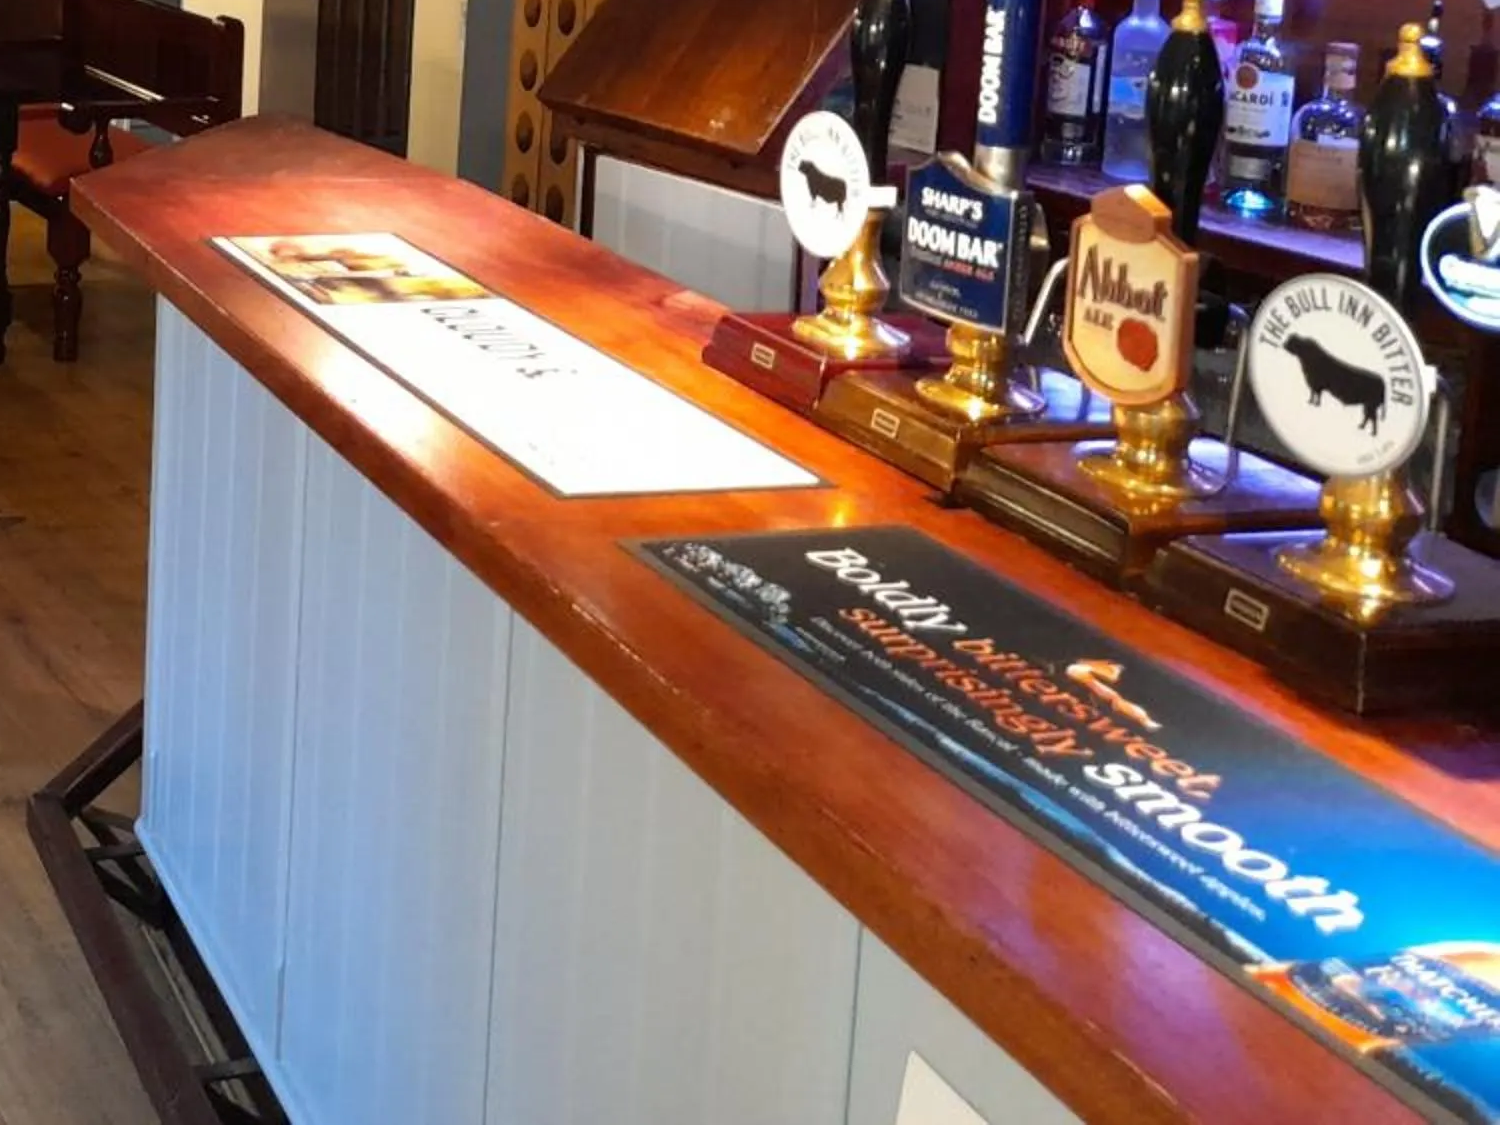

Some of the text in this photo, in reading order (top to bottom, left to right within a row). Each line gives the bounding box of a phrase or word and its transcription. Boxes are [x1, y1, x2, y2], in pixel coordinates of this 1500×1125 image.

[977, 54, 1003, 124] DOOM
[907, 215, 956, 258] DOOM
[957, 231, 999, 269] BAR
[921, 186, 984, 221] SHARP'S
[1078, 243, 1169, 323] Abbot
[1259, 285, 1414, 407] THE BULL INN BITTER
[804, 546, 969, 633] Boldly
[837, 606, 1366, 937] surprisingly smooth
